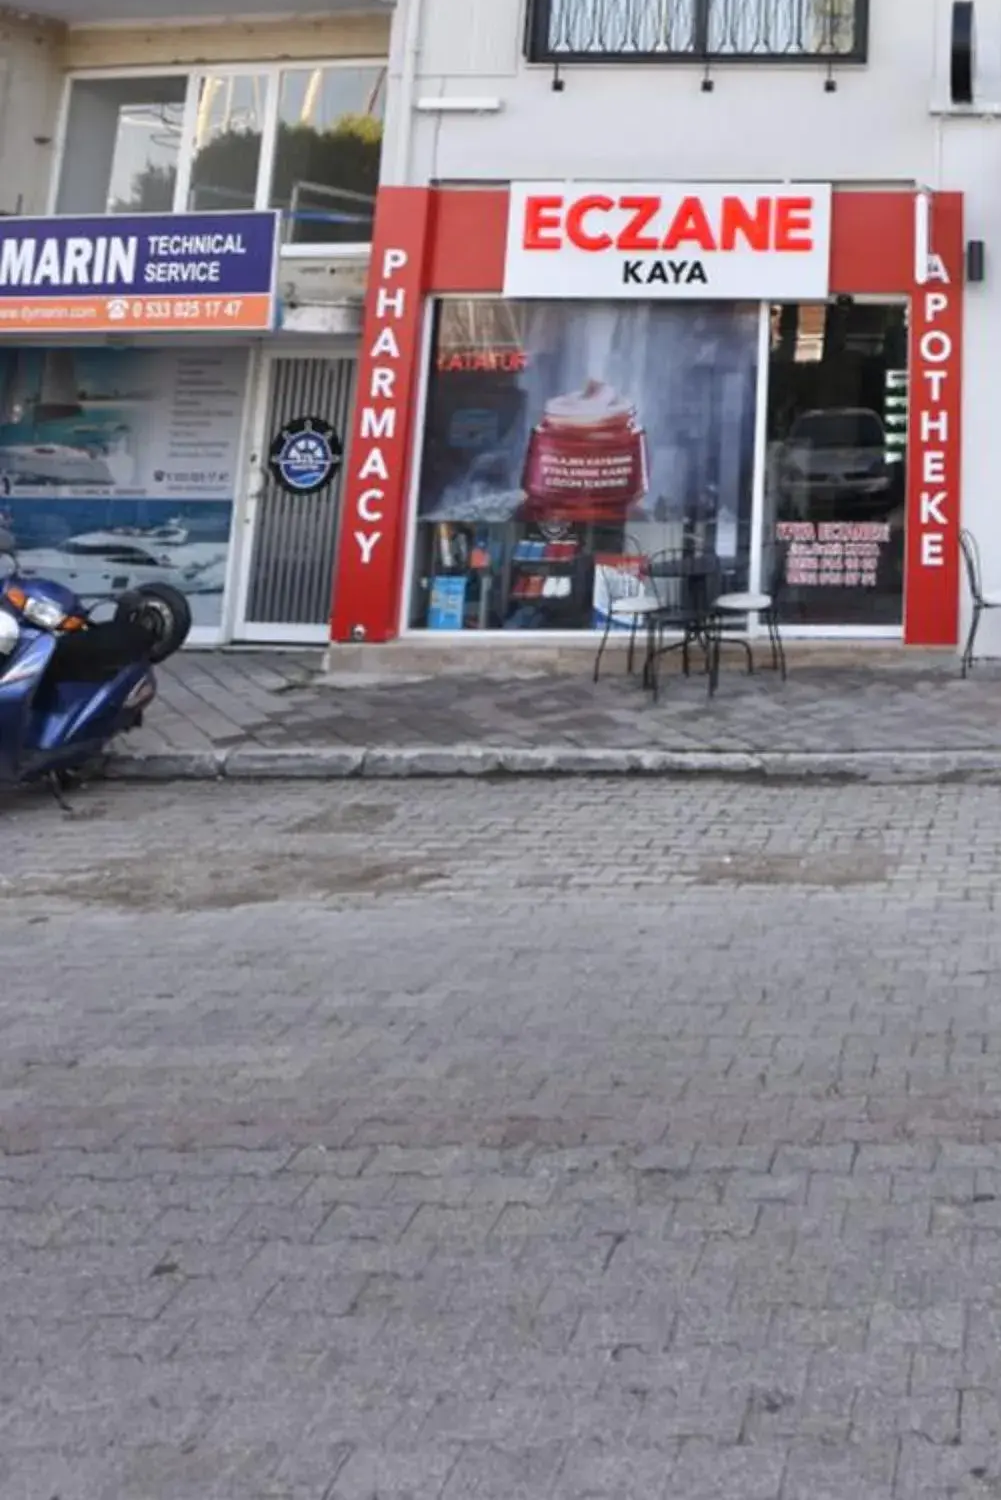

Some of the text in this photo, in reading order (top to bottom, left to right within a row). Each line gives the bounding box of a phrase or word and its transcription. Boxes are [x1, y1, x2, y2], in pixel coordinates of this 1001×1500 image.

[523, 195, 814, 251] ECZANE
[0, 234, 246, 286] MARIN TECHNICAL
[144, 262, 220, 283] SERVICE
[622, 260, 708, 284] KAYA
[355, 248, 407, 564] PHARMACY
[919, 253, 952, 567] APOTHEKE
